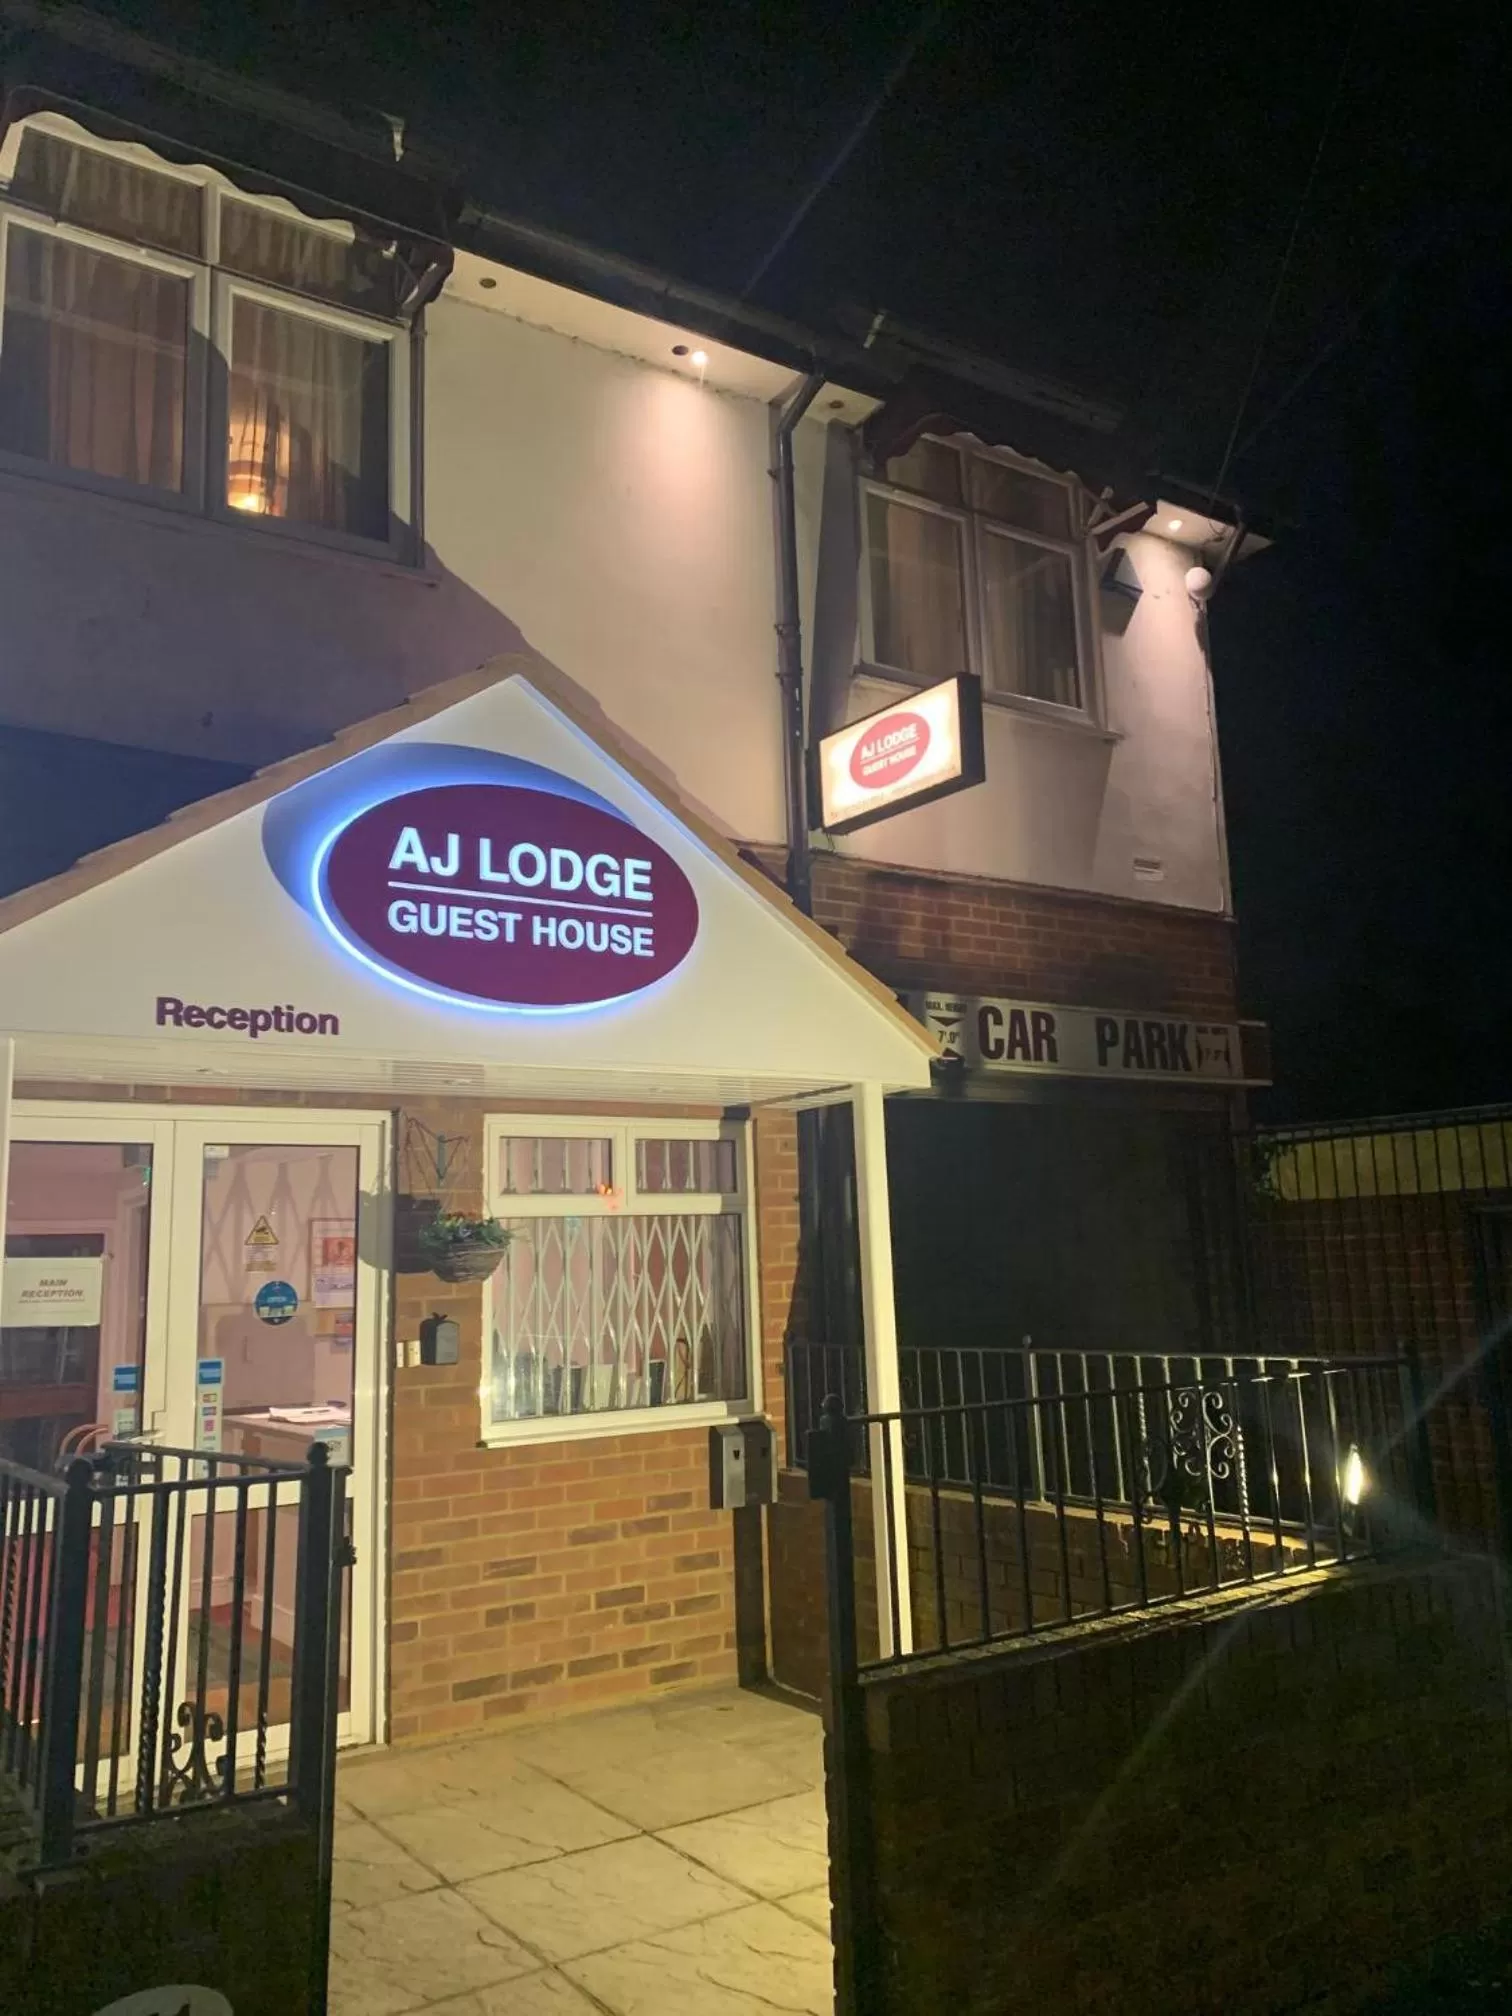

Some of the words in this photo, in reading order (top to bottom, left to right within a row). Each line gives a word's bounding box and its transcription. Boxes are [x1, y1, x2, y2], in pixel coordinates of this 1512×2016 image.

[877, 723, 917, 753] LODGE
[388, 826, 460, 877] AJ
[479, 837, 654, 901] LODGE
[387, 899, 523, 942] GUEST
[532, 915, 655, 957] HOUSE
[156, 996, 340, 1039] Reception
[977, 1005, 1058, 1063] CAR
[1094, 1015, 1193, 1072] PARK
[21, 1289, 84, 1298] RECEPTION
[39, 1278, 69, 1287] MAIN
